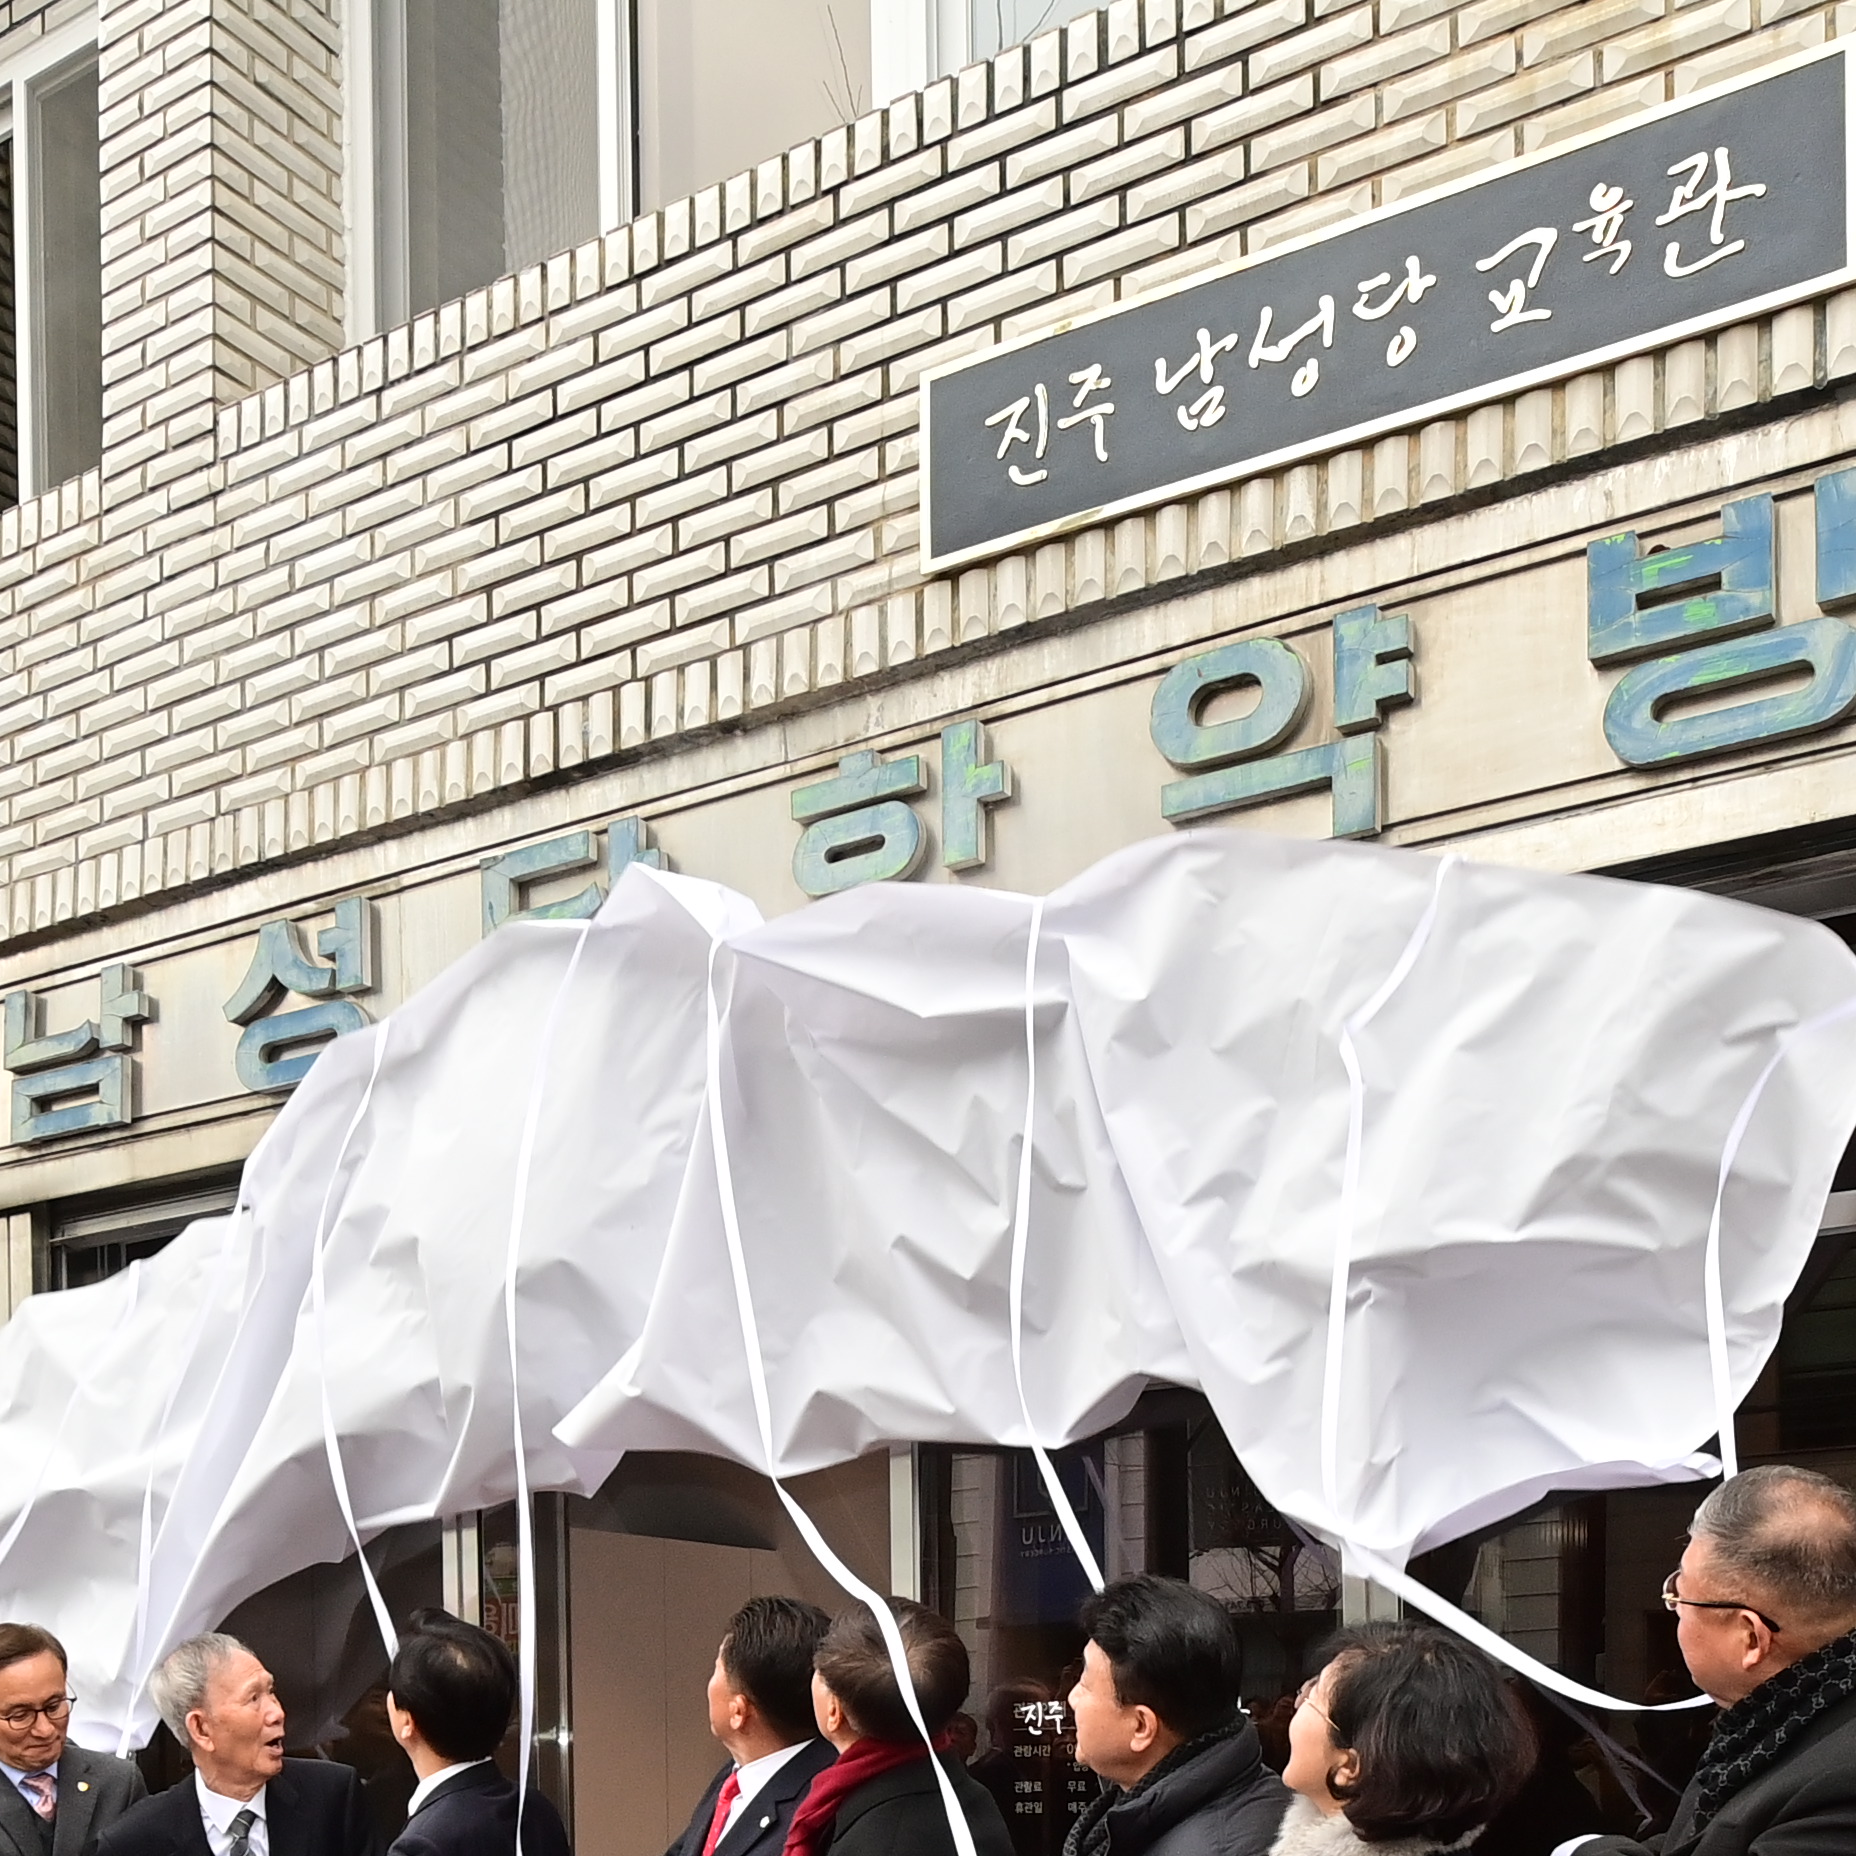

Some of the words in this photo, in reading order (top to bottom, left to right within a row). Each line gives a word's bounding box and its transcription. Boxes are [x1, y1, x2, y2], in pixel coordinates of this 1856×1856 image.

[984, 364, 1116, 486] 진주
[1153, 253, 1437, 431] 남성당
[1474, 145, 1768, 333] 교육관
[1020, 1700, 1065, 1735] 진주
[1013, 1744, 1051, 1758] 관람시간
[1067, 1780, 1087, 1793] 무료
